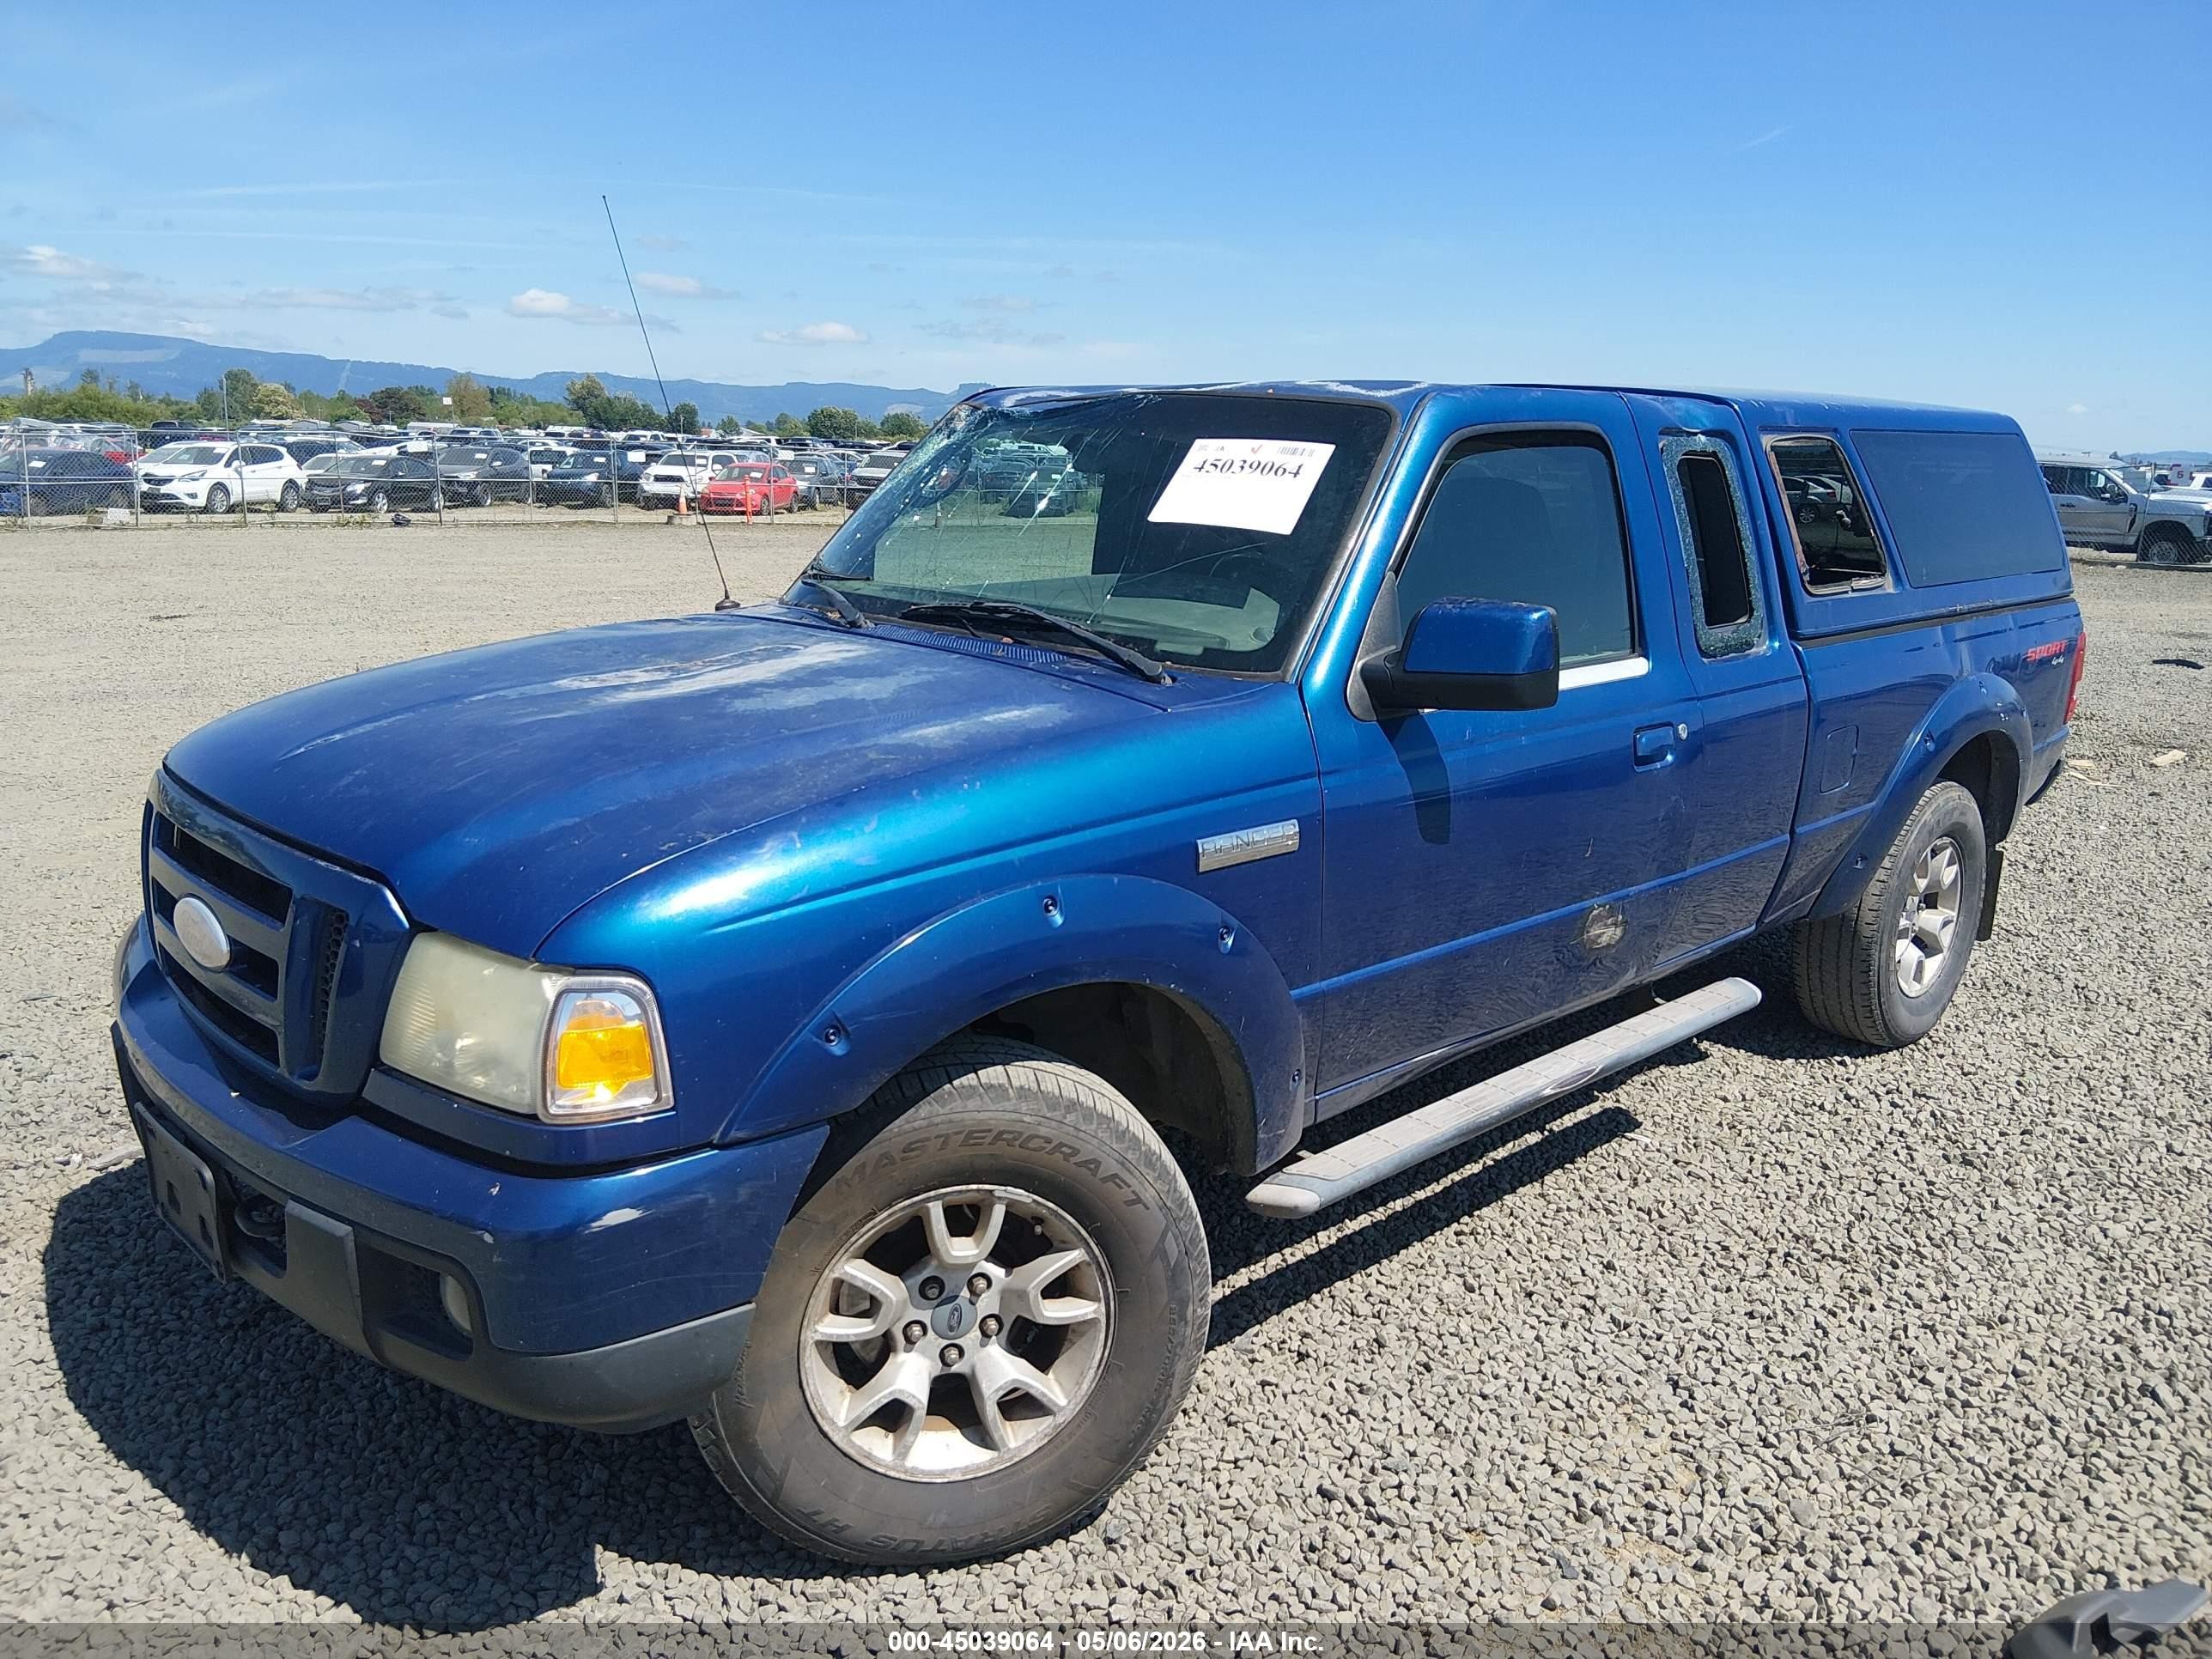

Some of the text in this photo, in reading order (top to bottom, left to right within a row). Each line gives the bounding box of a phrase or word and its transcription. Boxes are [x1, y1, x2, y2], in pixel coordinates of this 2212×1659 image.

[1193, 458, 1304, 478] 45039064
[2027, 641, 2066, 660] SPORT
[1201, 823, 1298, 859] RANGER
[836, 1127, 1150, 1211] MASTERCRAFT
[795, 1507, 853, 1534] HT
